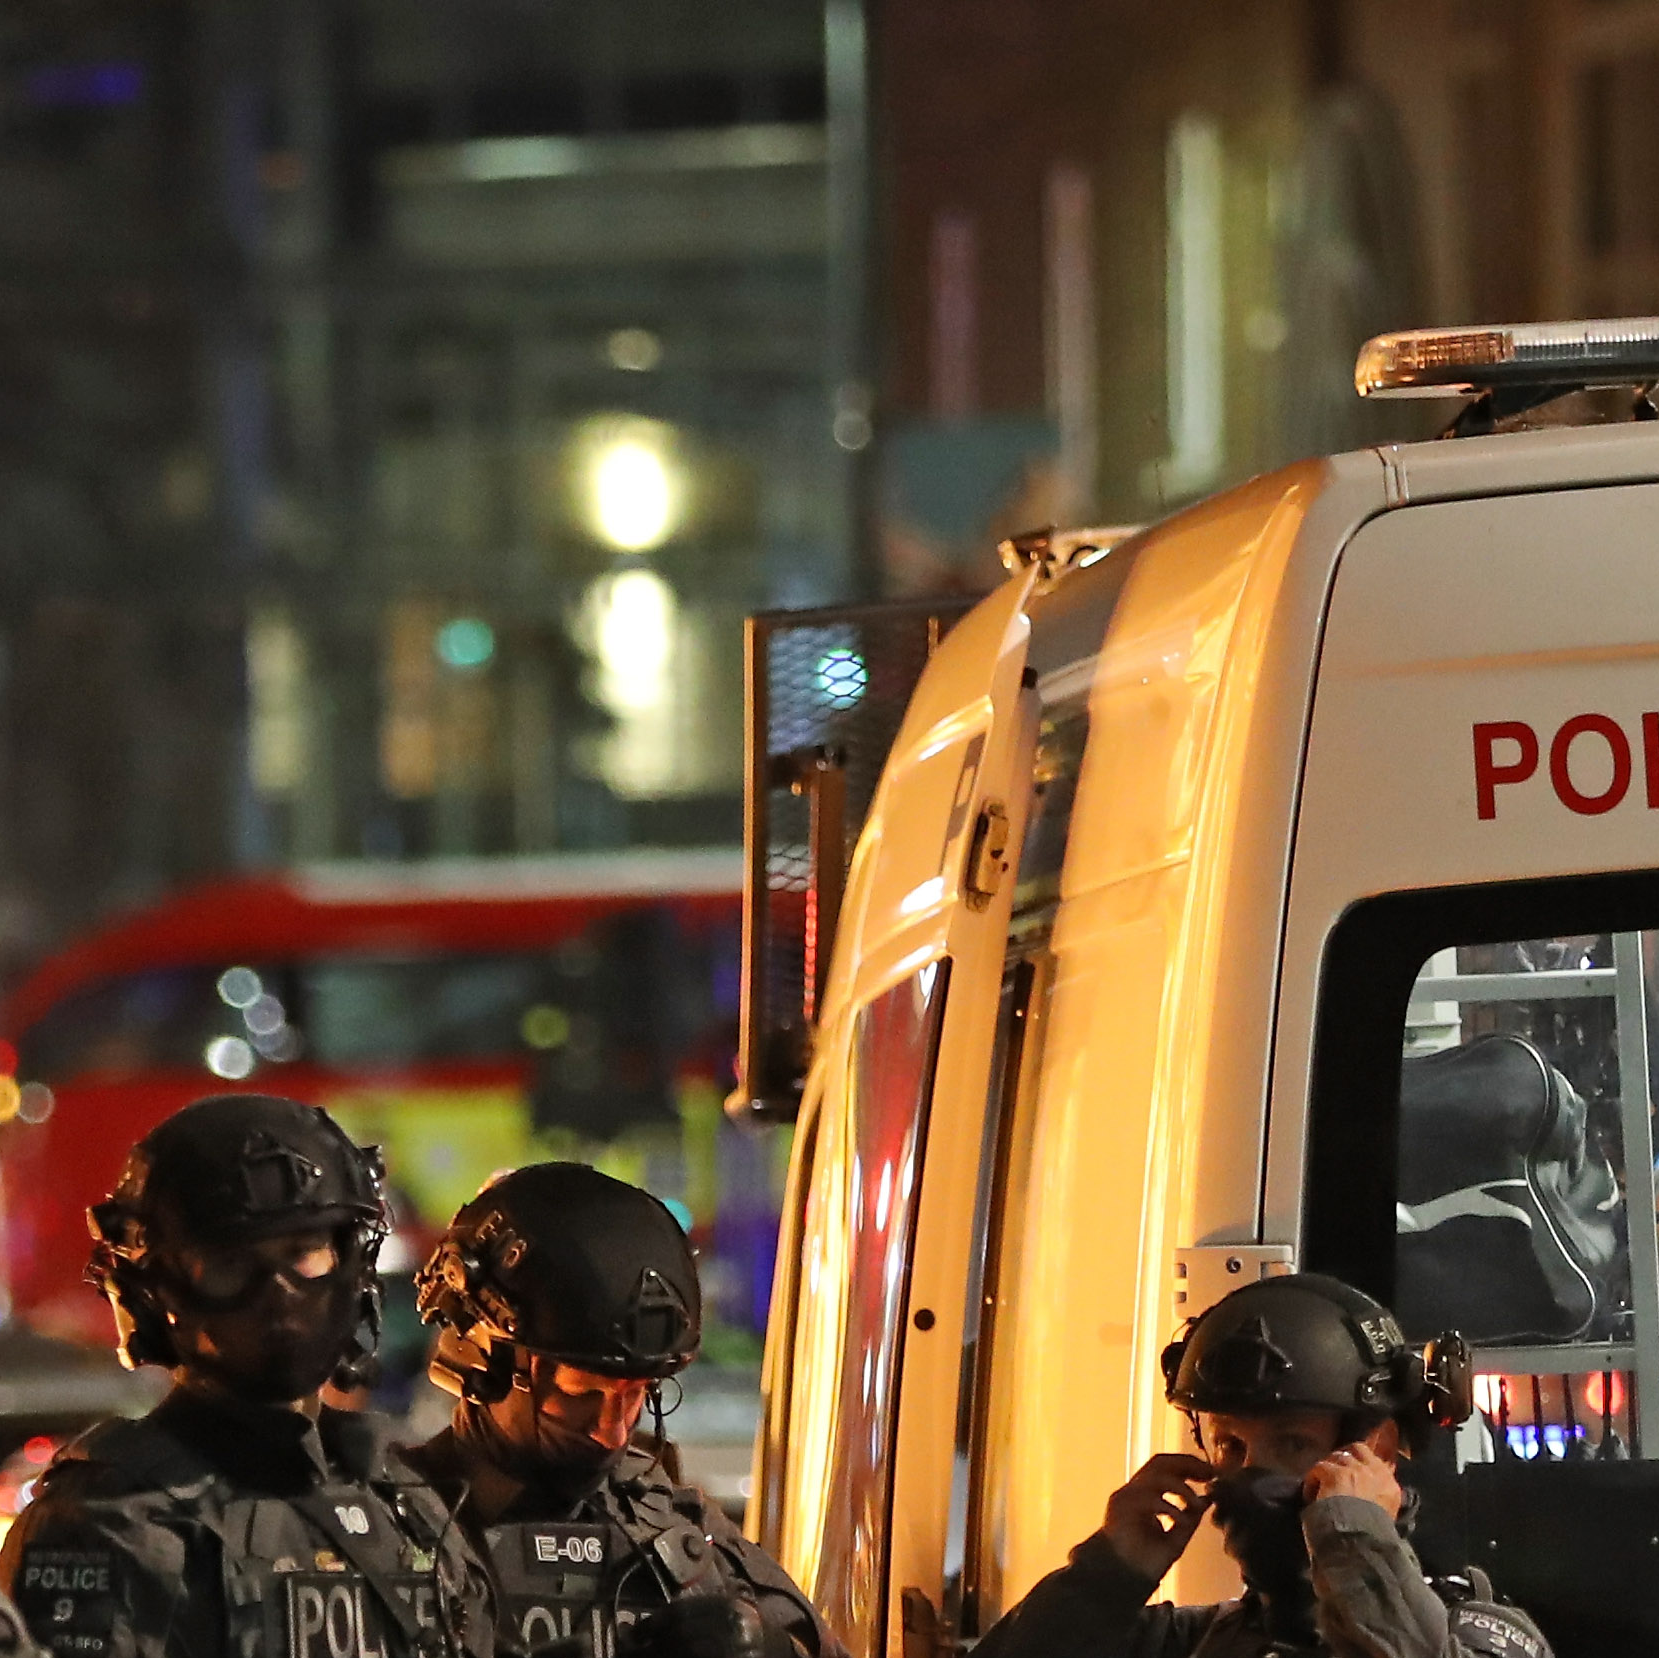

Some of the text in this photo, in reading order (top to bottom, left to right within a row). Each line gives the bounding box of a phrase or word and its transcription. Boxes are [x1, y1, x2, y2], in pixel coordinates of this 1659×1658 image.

[534, 1535, 604, 1563] E-06
[24, 1566, 110, 1592] POLICE
[53, 1597, 75, 1622] 9
[1458, 1616, 1540, 1658] POLICE
